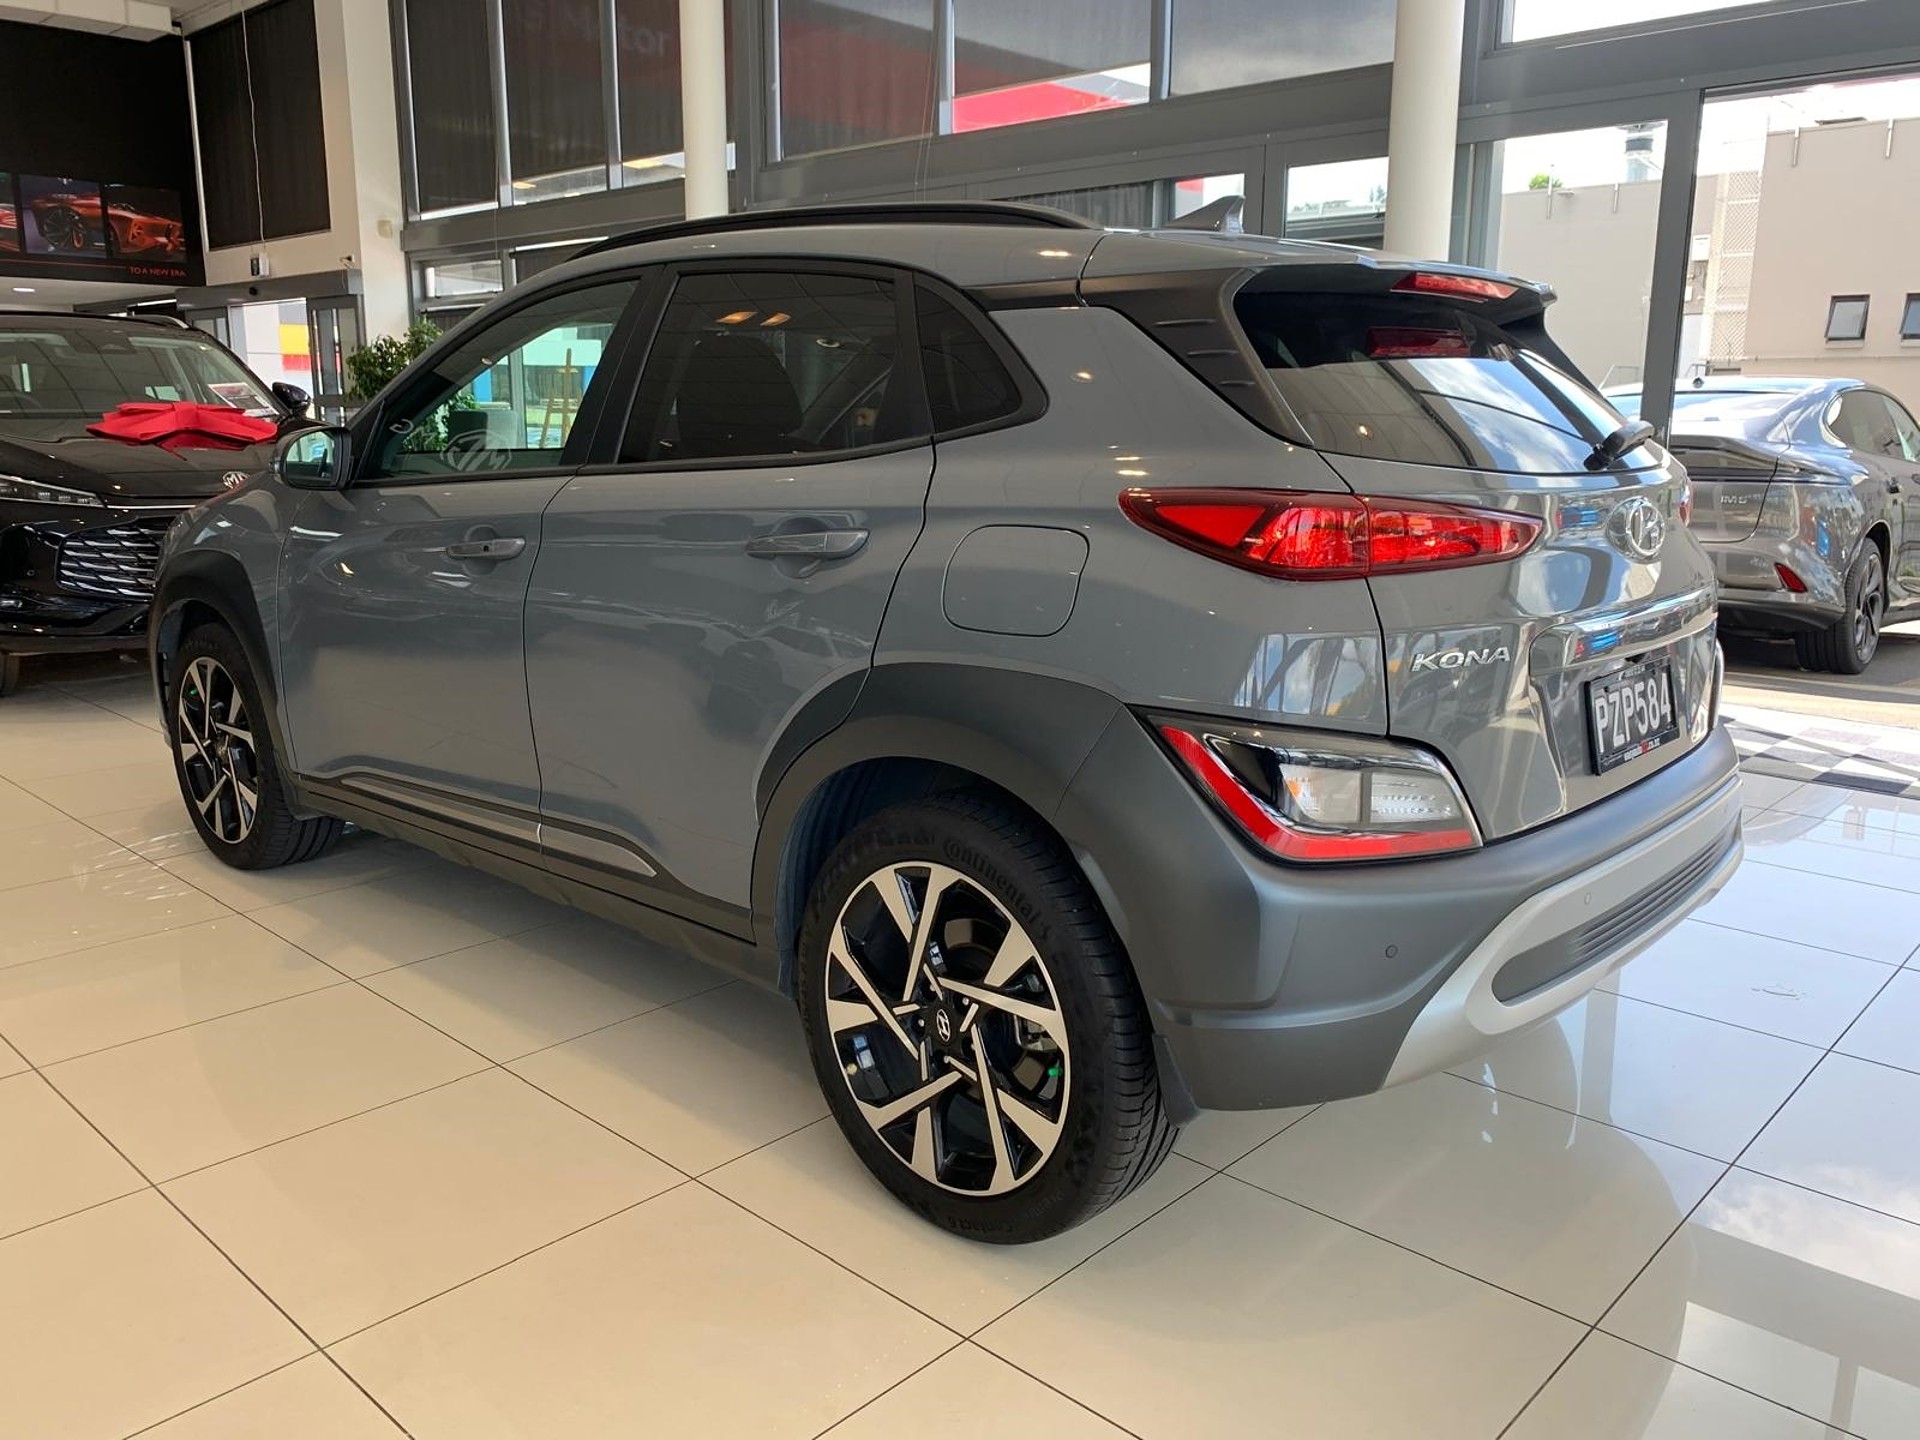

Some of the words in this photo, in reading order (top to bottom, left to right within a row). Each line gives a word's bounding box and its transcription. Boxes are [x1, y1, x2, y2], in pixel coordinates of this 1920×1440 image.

[129, 266, 141, 275] TO
[1410, 646, 1511, 672] KONA
[1594, 672, 1672, 754] PZP584
